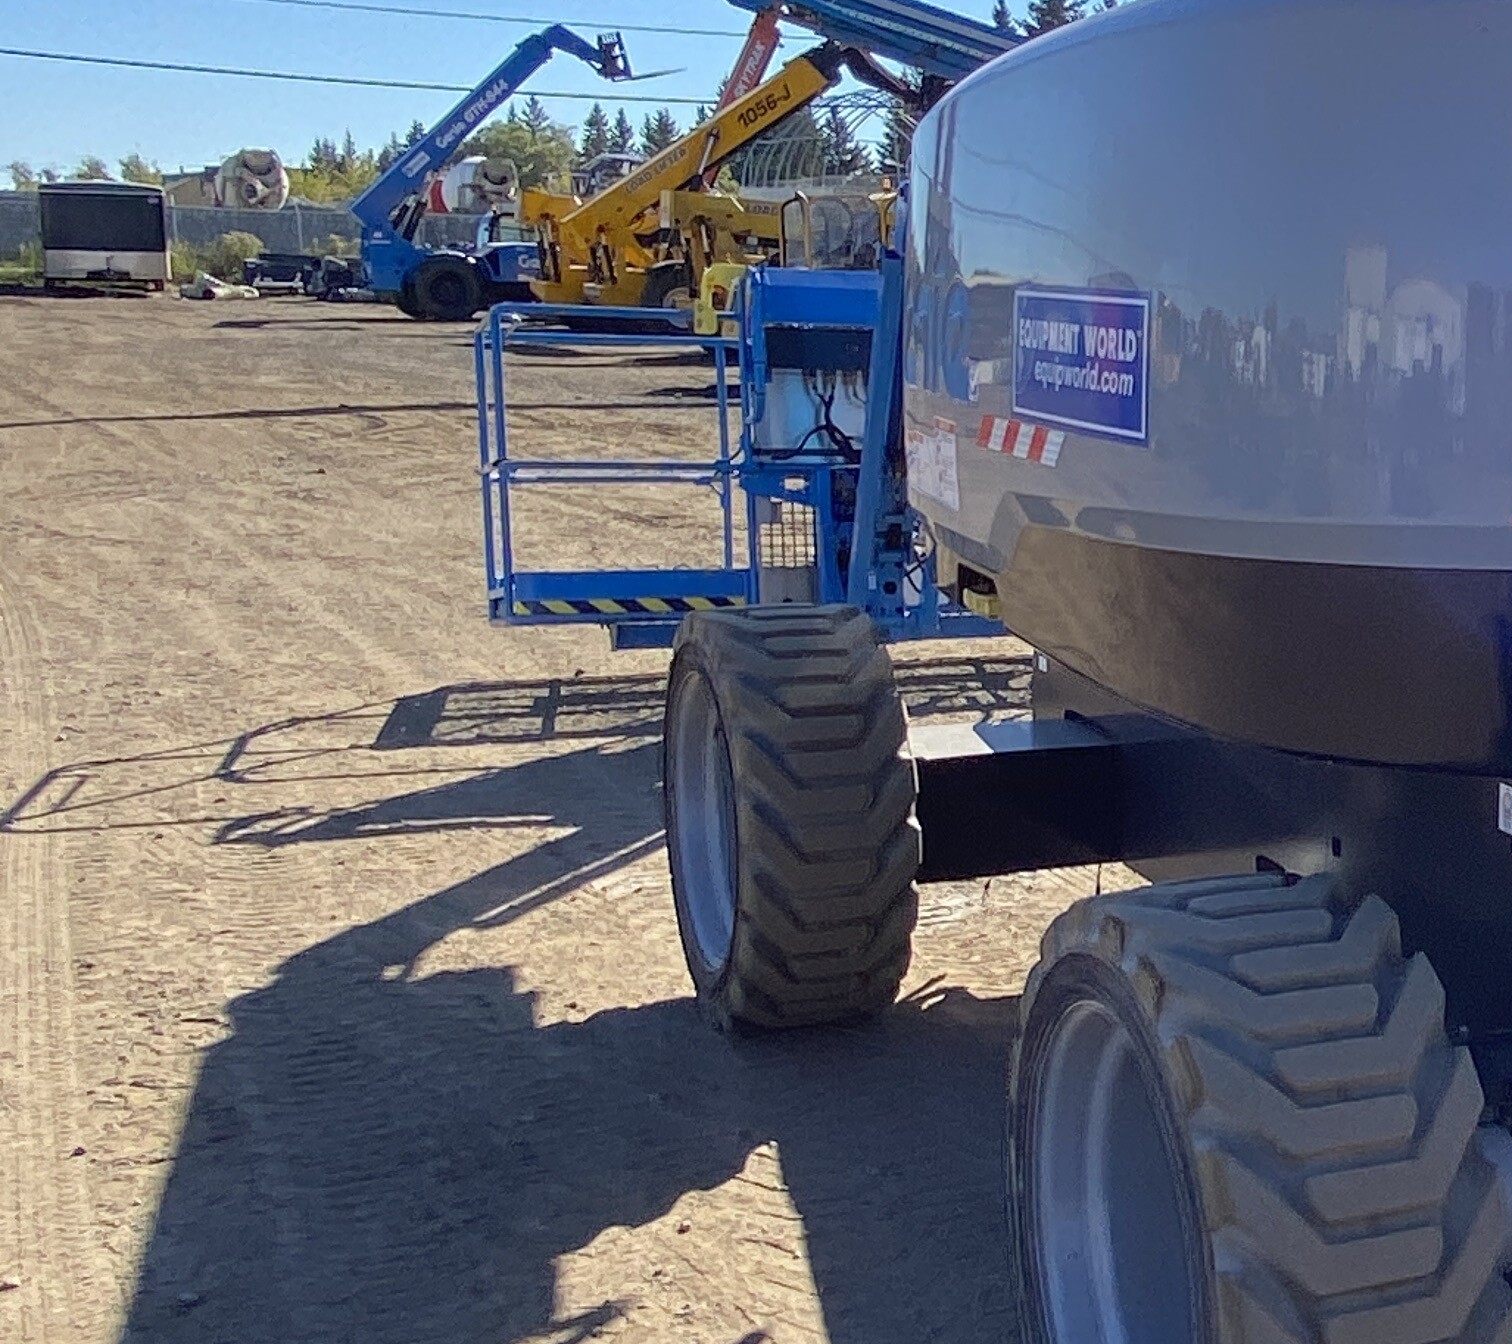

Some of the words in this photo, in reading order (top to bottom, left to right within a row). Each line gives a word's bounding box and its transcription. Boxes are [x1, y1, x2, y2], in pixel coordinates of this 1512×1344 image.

[738, 84, 791, 129] 1056-J
[1019, 318, 1080, 354] EQUIPMENT
[1083, 325, 1138, 362] WORLD
[1034, 356, 1134, 396] equipworld.com
